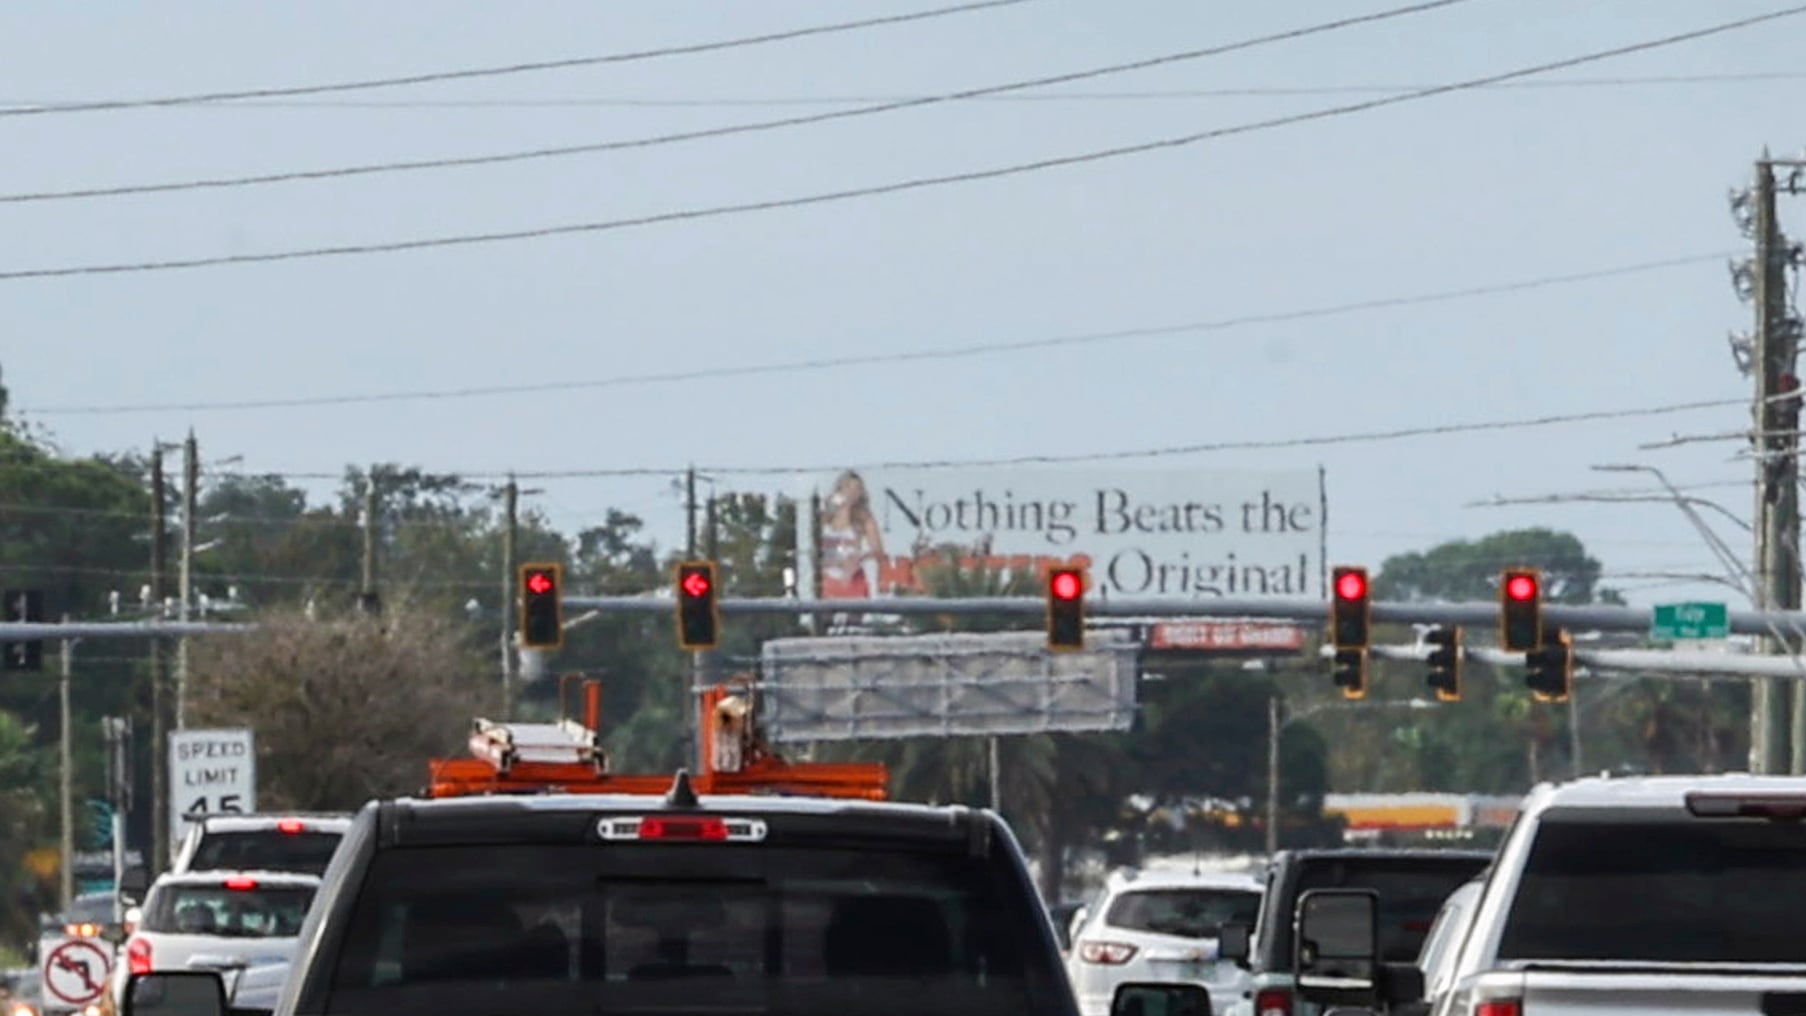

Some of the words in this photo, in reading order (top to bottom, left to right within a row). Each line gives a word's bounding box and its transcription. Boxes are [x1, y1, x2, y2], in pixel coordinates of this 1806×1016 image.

[884, 488, 1077, 543] Nothing
[1097, 488, 1223, 533] Beats
[1242, 489, 1312, 533] the
[1108, 548, 1307, 598] Original
[178, 741, 246, 761] SPEED
[185, 768, 239, 786] LIMIT
